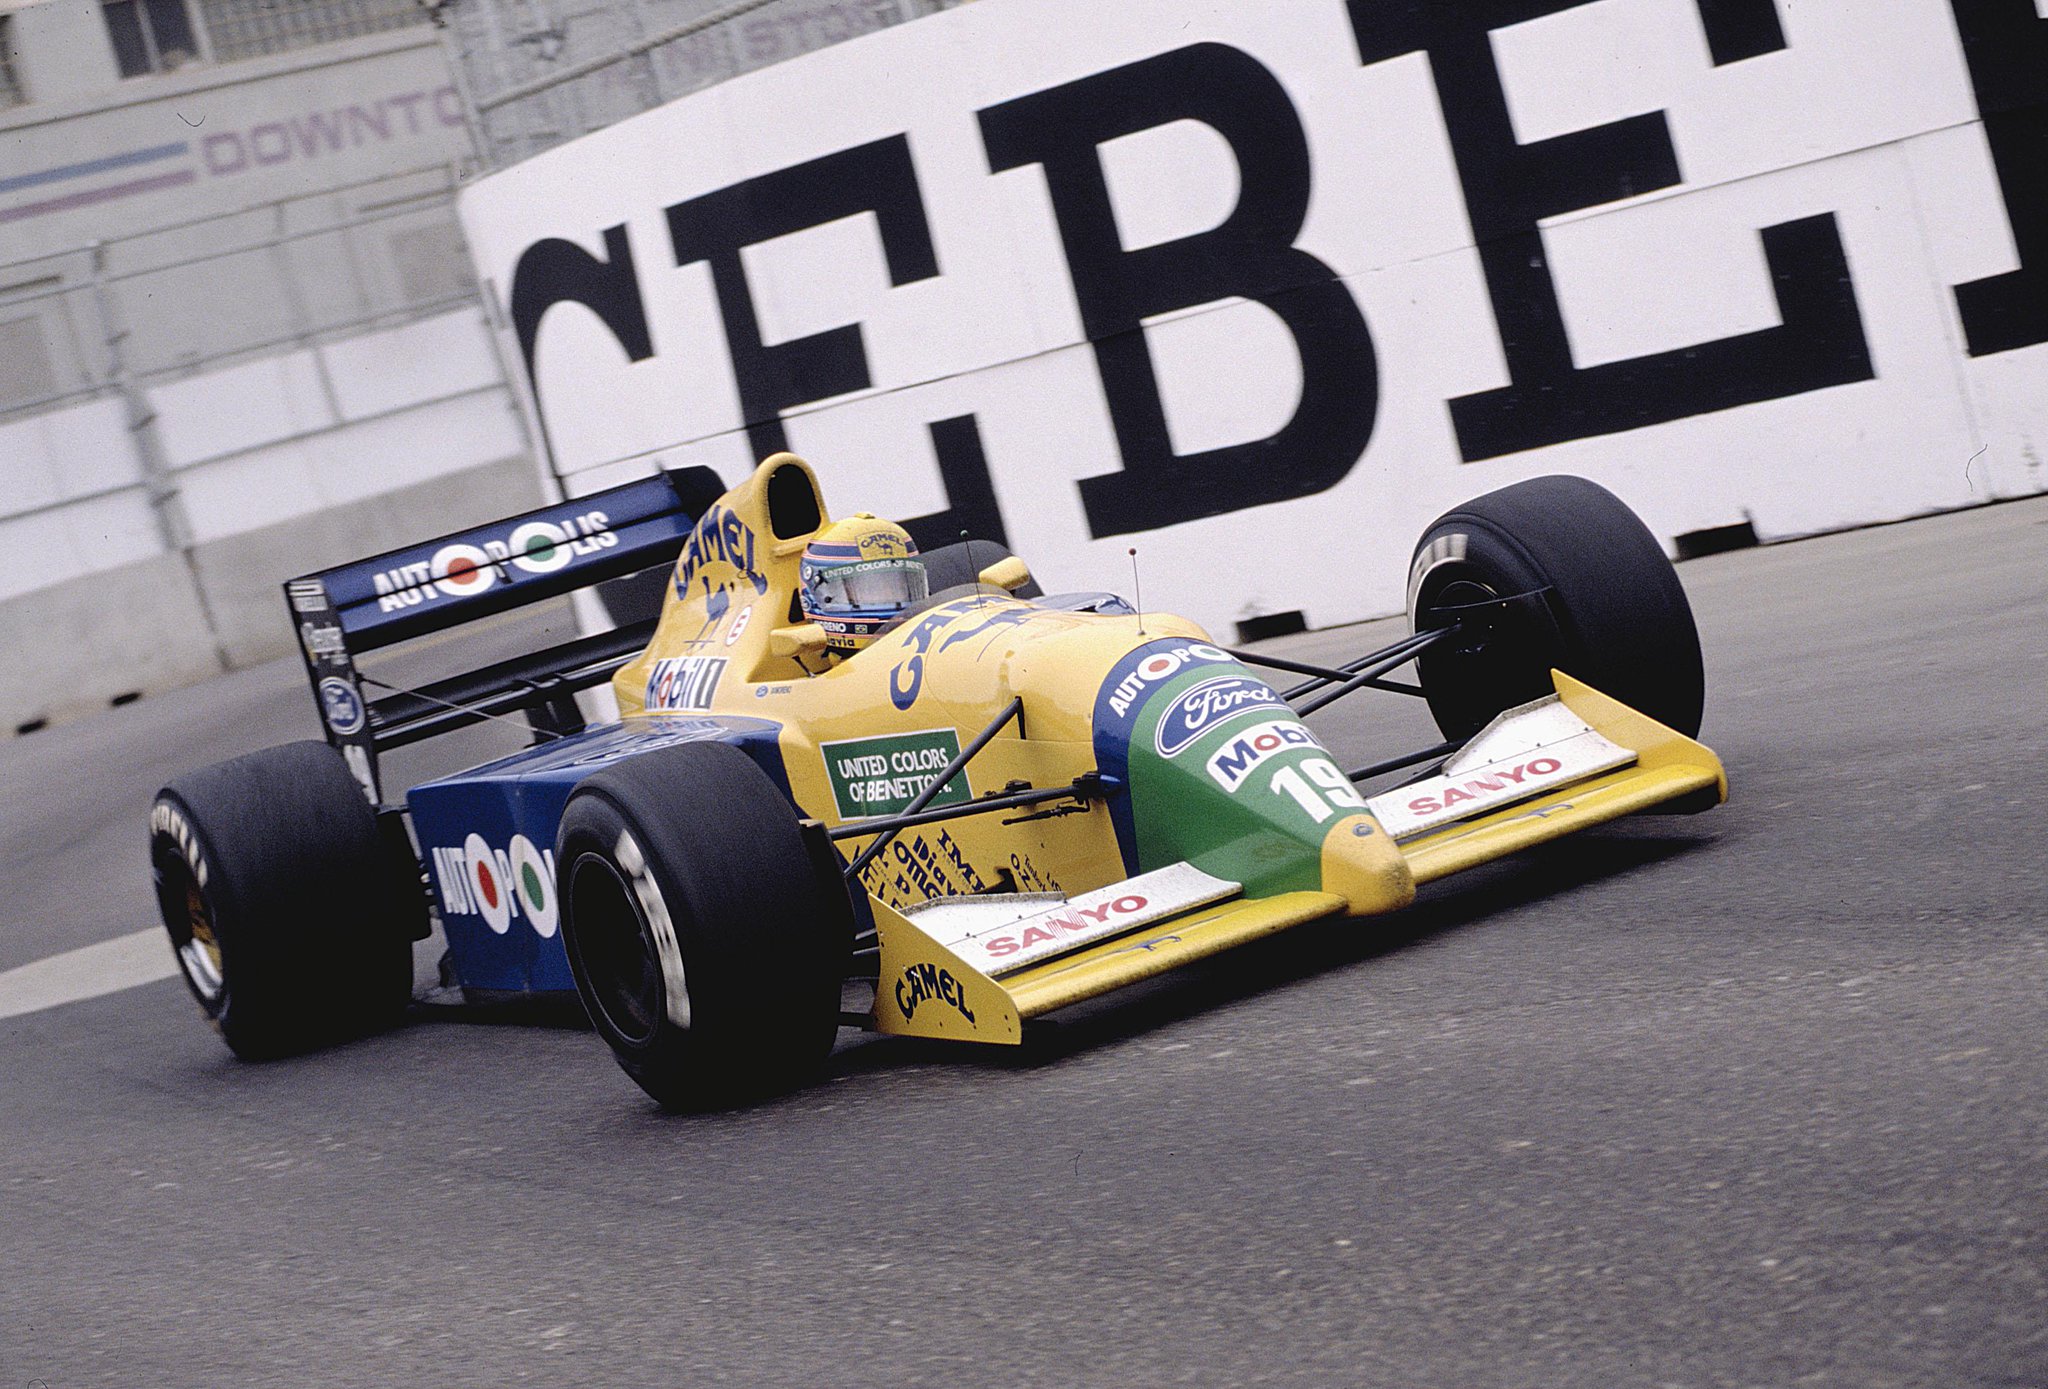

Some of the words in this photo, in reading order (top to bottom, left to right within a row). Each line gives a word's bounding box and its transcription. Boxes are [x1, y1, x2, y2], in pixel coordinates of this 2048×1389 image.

[373, 511, 618, 612] AUTOPOLIS
[674, 504, 768, 601] CAMEL
[823, 566, 853, 579] UNITED
[855, 560, 891, 573] COLORS
[860, 533, 903, 549] CAMEL
[827, 635, 855, 647] avia
[1109, 644, 1234, 718] AUTOPO
[1184, 681, 1276, 730] Ford
[837, 754, 888, 779] UNITED
[892, 747, 949, 773] COLORS
[850, 781, 865, 803] OF
[1270, 758, 1369, 824] 19
[1408, 758, 1562, 816] SANYO
[985, 895, 1149, 958] SANYO
[895, 963, 975, 1024] CAMEL
